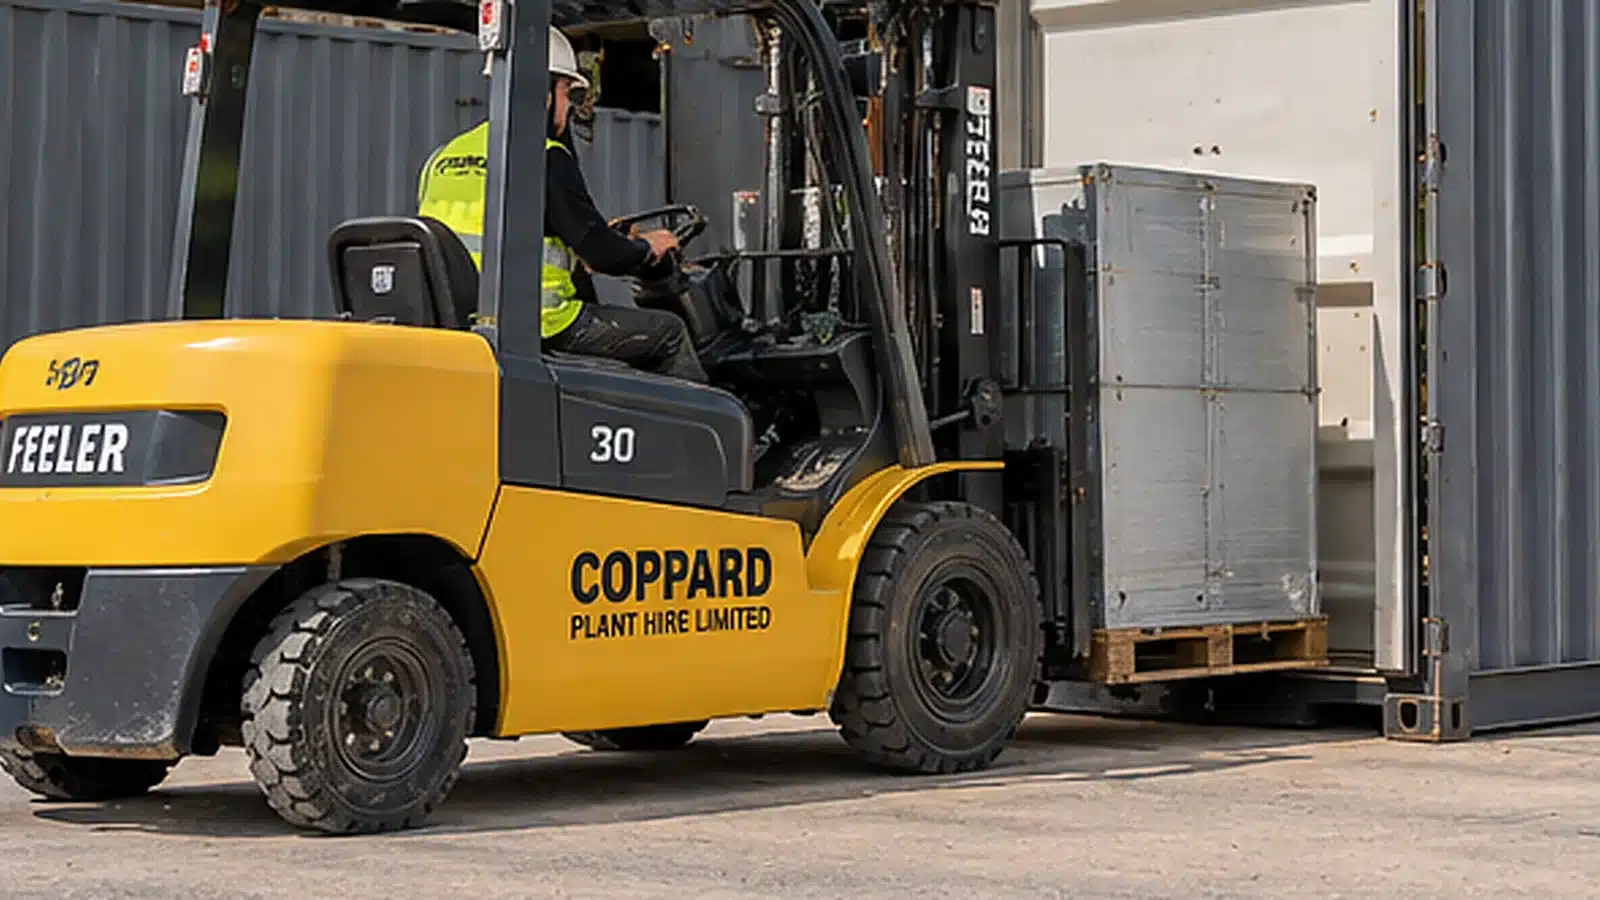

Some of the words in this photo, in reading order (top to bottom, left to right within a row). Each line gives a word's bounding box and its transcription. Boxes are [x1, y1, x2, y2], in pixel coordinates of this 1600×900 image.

[8, 424, 128, 473] FEELER
[591, 426, 634, 462] 30
[571, 547, 772, 604] COPPARD
[570, 612, 638, 640] PLANT
[643, 609, 689, 636] HIRE
[695, 606, 771, 632] LIMITED
